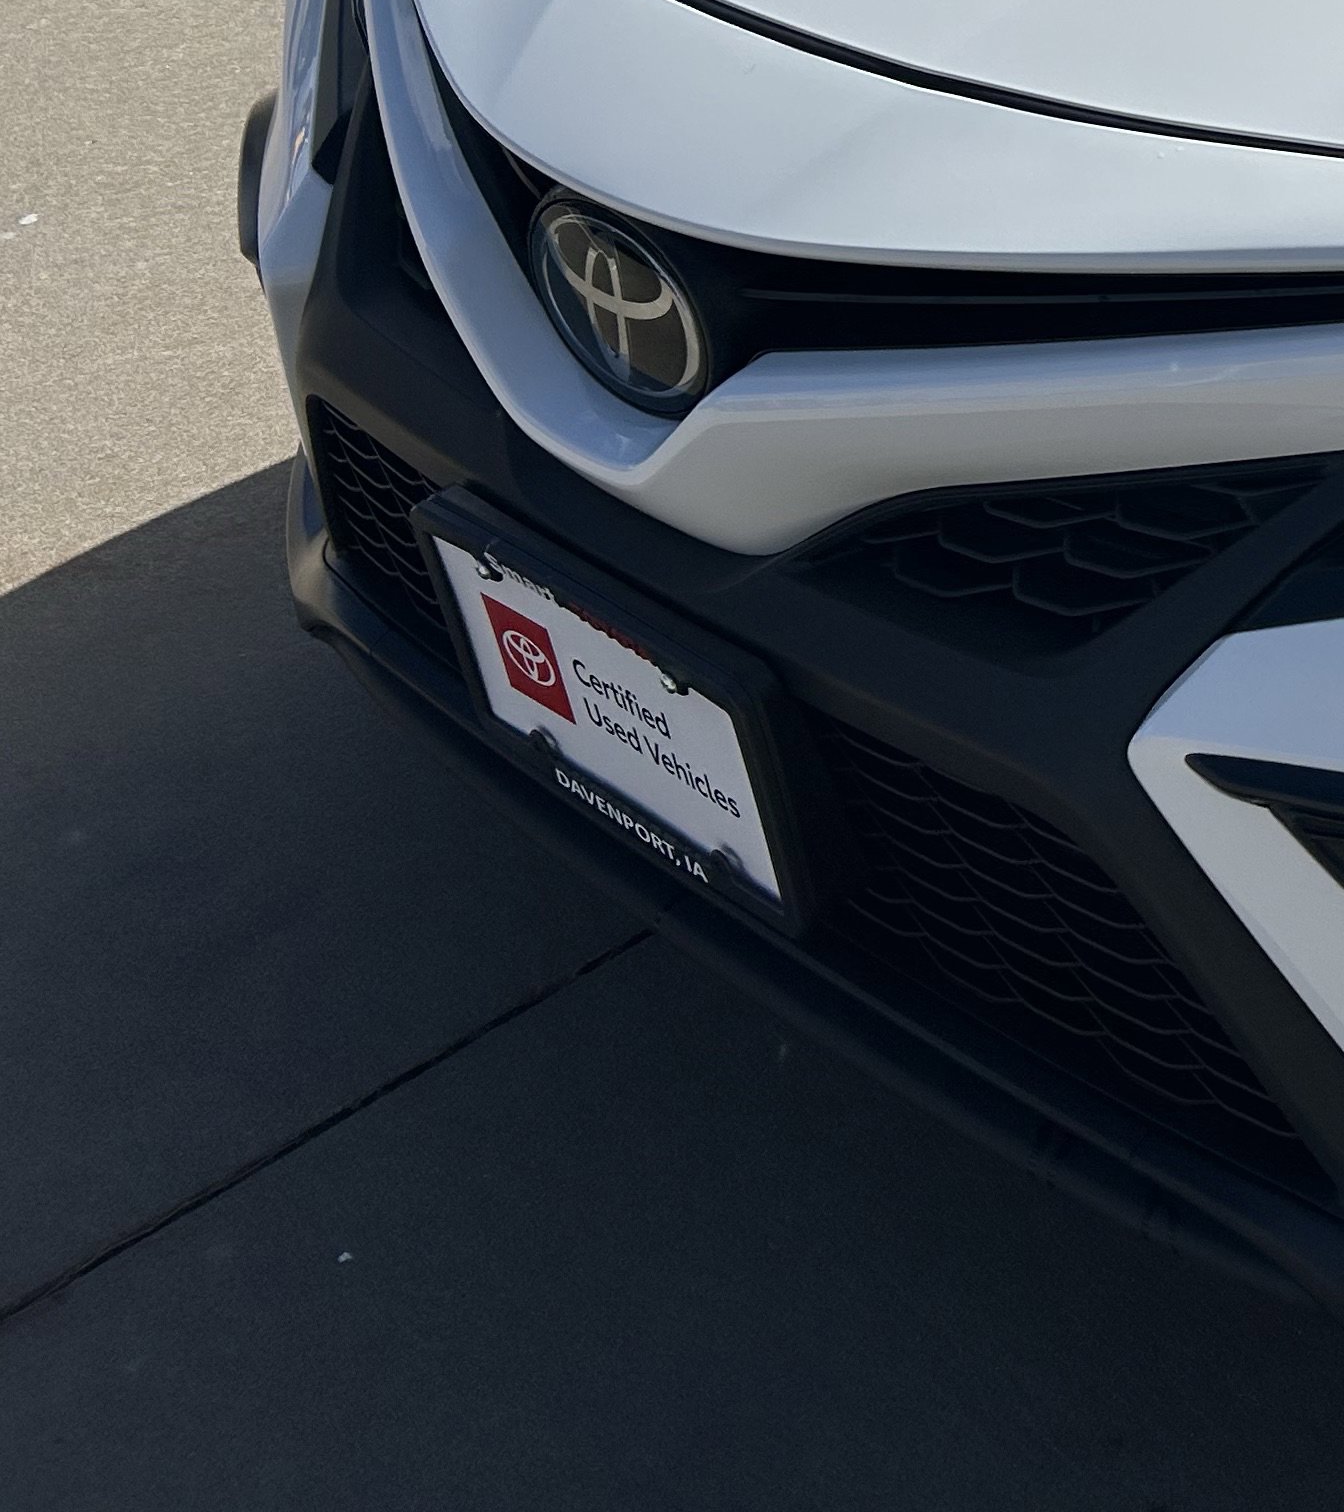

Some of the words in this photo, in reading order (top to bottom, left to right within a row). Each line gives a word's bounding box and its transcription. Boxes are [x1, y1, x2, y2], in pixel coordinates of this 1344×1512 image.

[572, 659, 672, 740] Certified
[583, 698, 643, 755] Used
[643, 735, 741, 819] Vehicles
[555, 768, 681, 867] DAVENPORT,
[684, 854, 709, 884] IA
